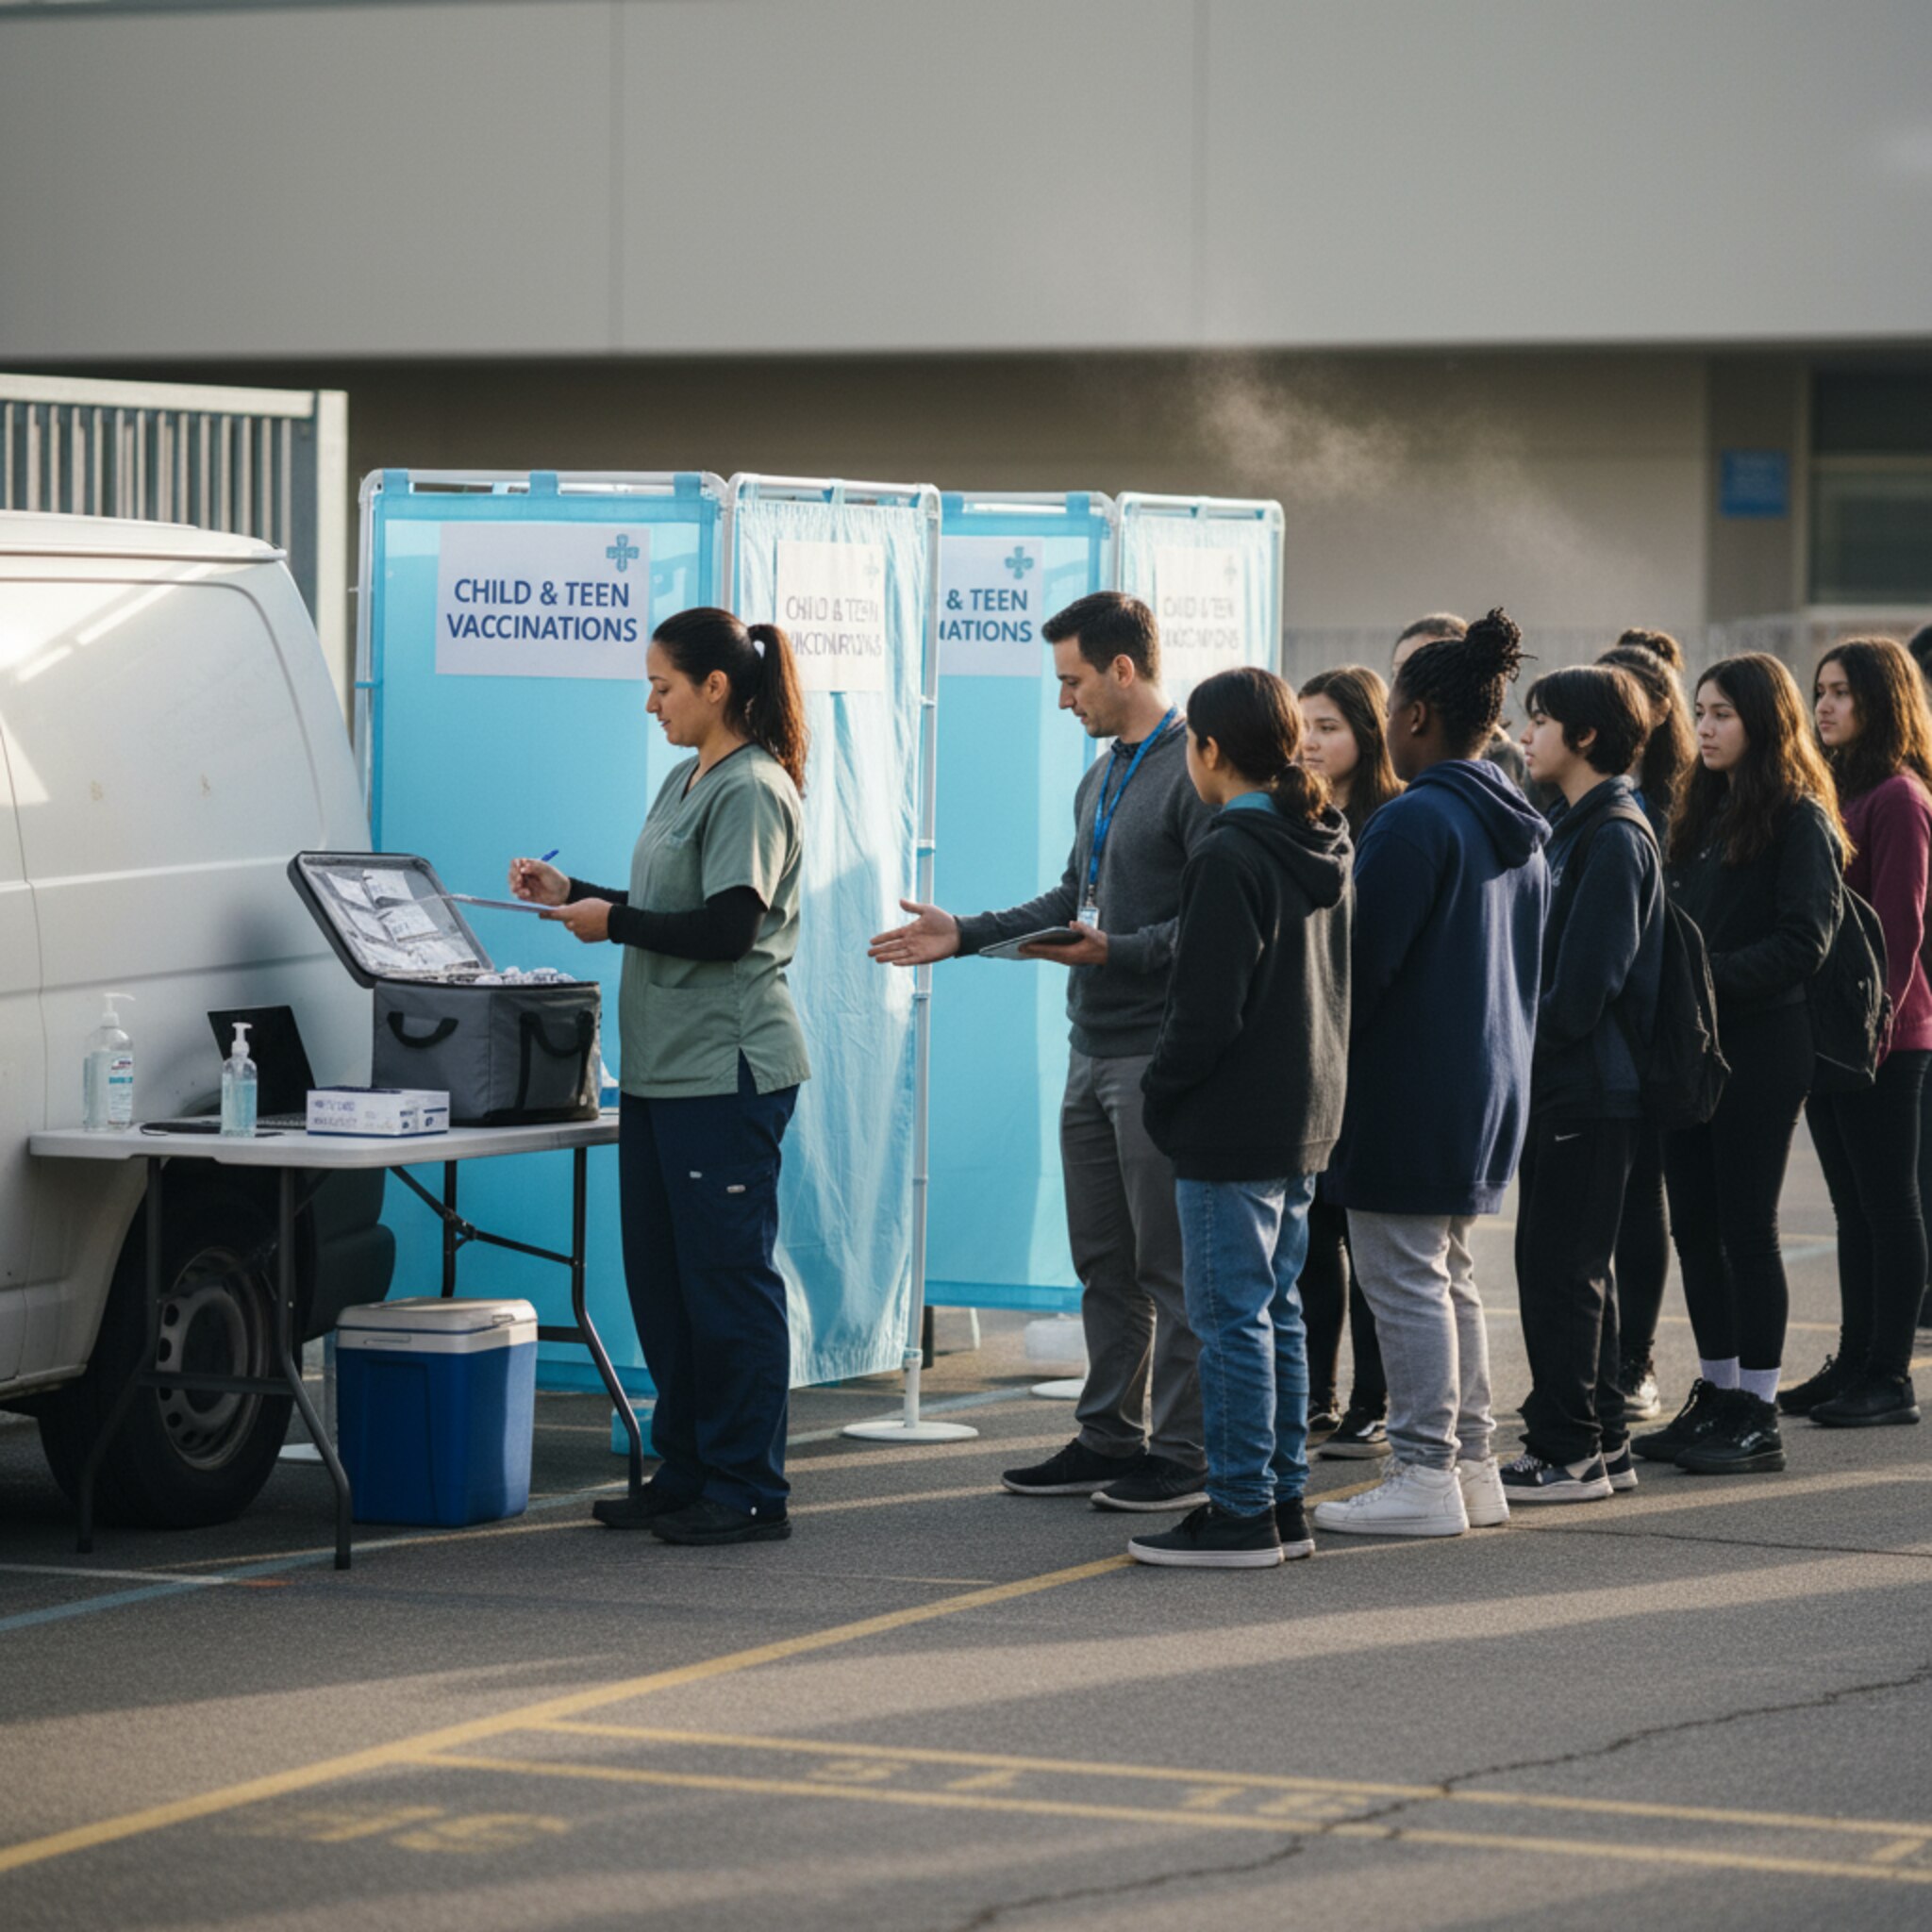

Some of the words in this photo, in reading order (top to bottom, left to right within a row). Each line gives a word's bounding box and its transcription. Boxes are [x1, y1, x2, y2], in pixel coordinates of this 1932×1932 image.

[454, 578, 532, 606] CHILD
[539, 580, 558, 607] &
[564, 581, 630, 608] TEEN
[945, 588, 963, 610] &
[970, 588, 1028, 611] TEEN
[446, 612, 639, 643] VACCINATIONS
